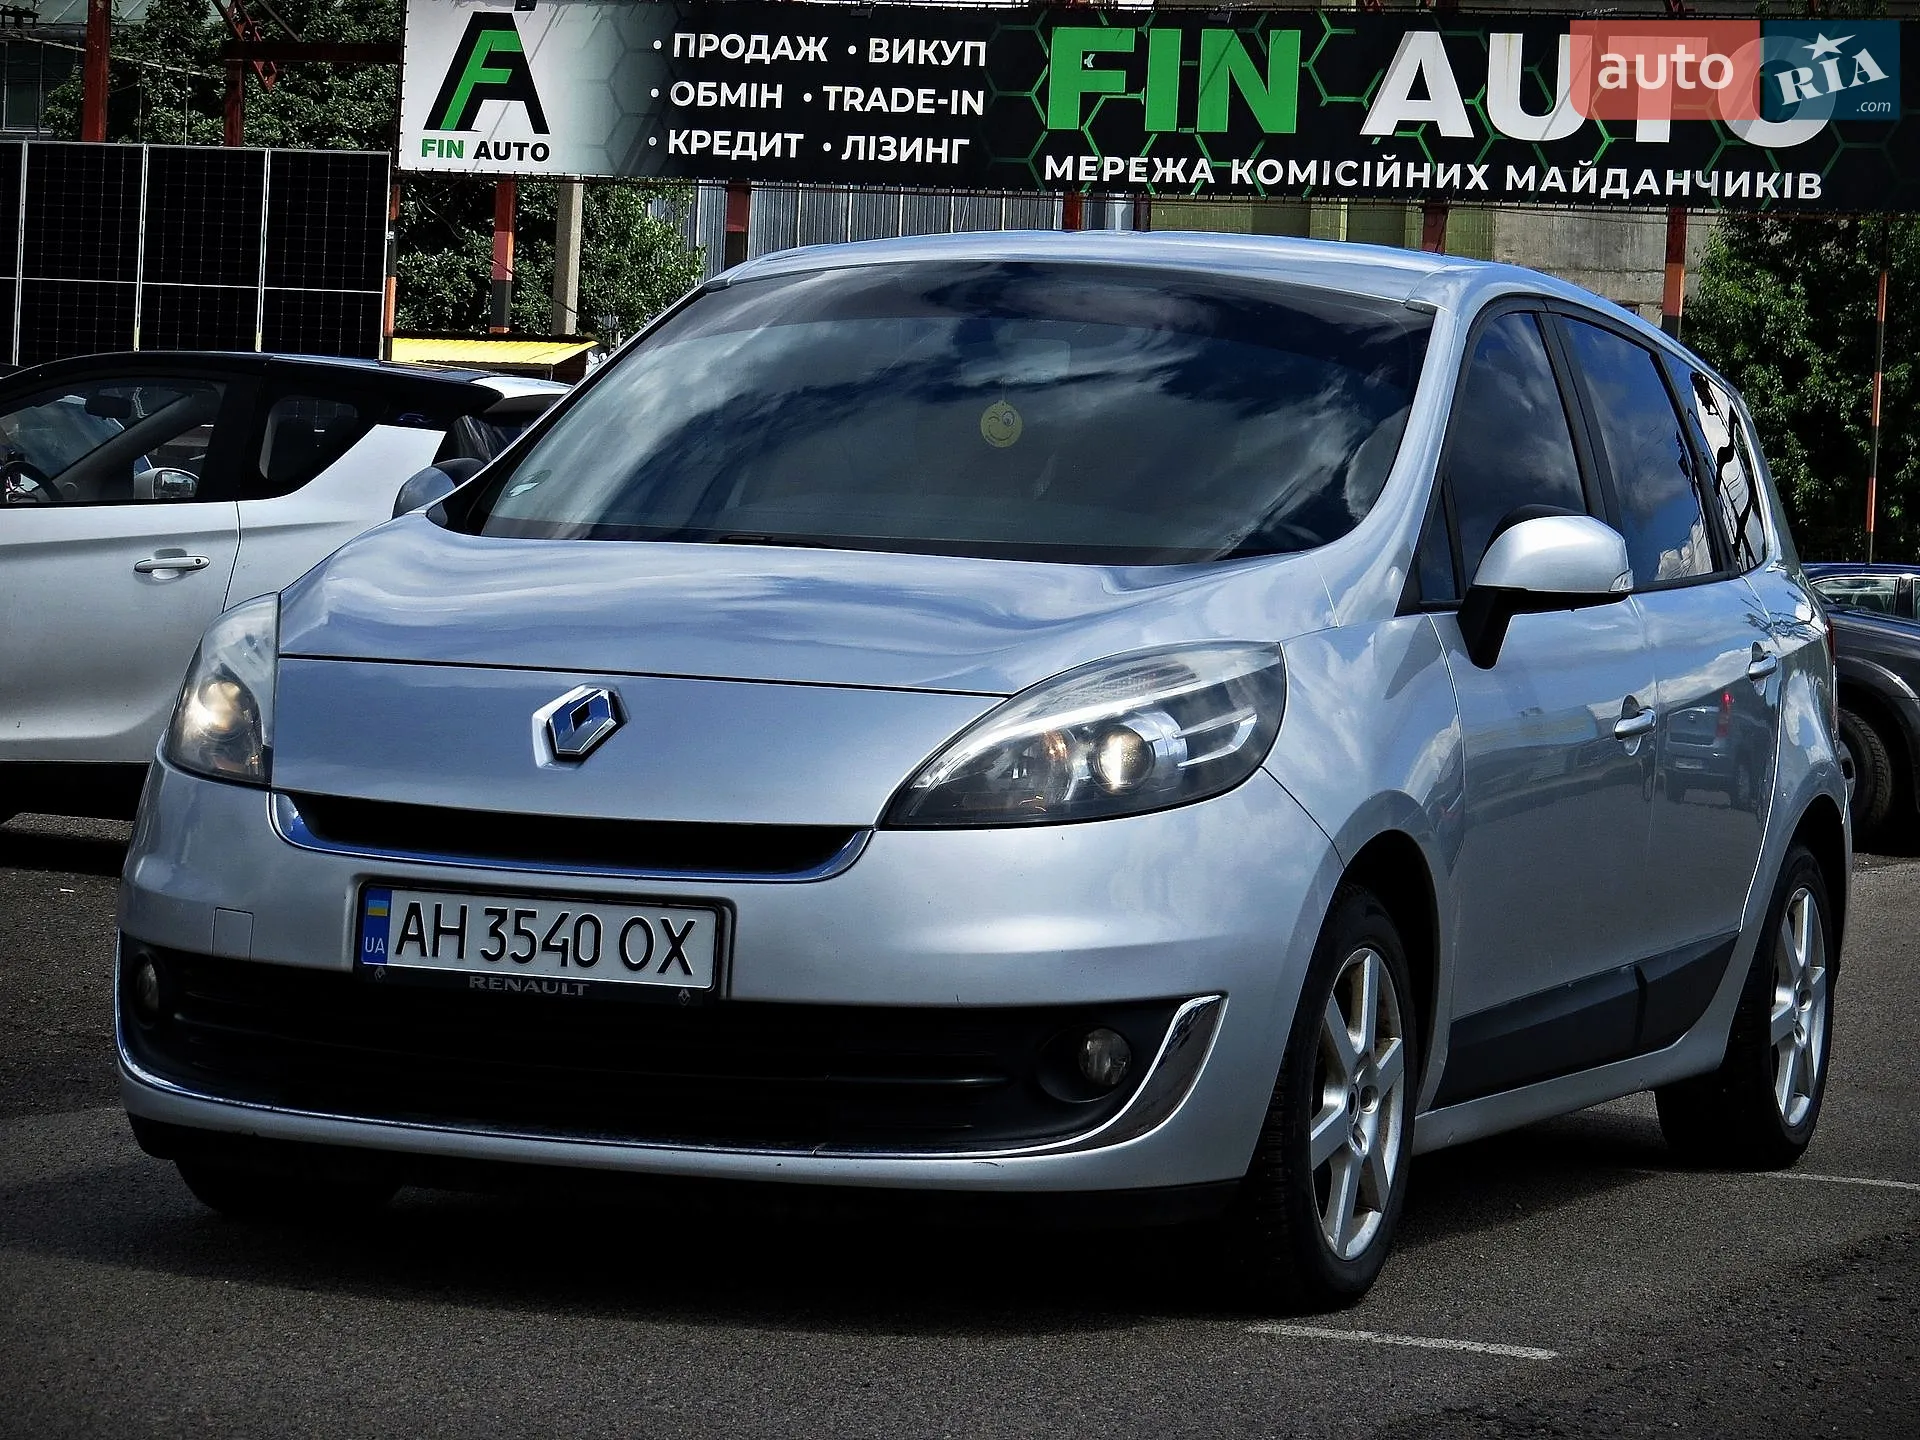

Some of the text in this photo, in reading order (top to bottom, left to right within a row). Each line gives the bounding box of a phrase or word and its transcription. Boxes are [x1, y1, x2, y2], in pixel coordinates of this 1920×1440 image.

[672, 33, 988, 68] ПРОДАЖ ВИКУП
[670, 80, 783, 109] ОБМІН
[822, 85, 985, 116] TRADE-IN
[1047, 26, 1837, 148] FIN AUTO
[421, 138, 550, 162] FIN AUTO
[667, 129, 970, 164] КРЕДИТ ЛІЗИНГ
[1044, 154, 1823, 200] МЕРЕЖА КОМІСІЙНИХ МАЙДАНЧИКІВ
[364, 936, 386, 955] UA
[480, 906, 603, 969] 3540
[468, 975, 591, 997] RENAULT
